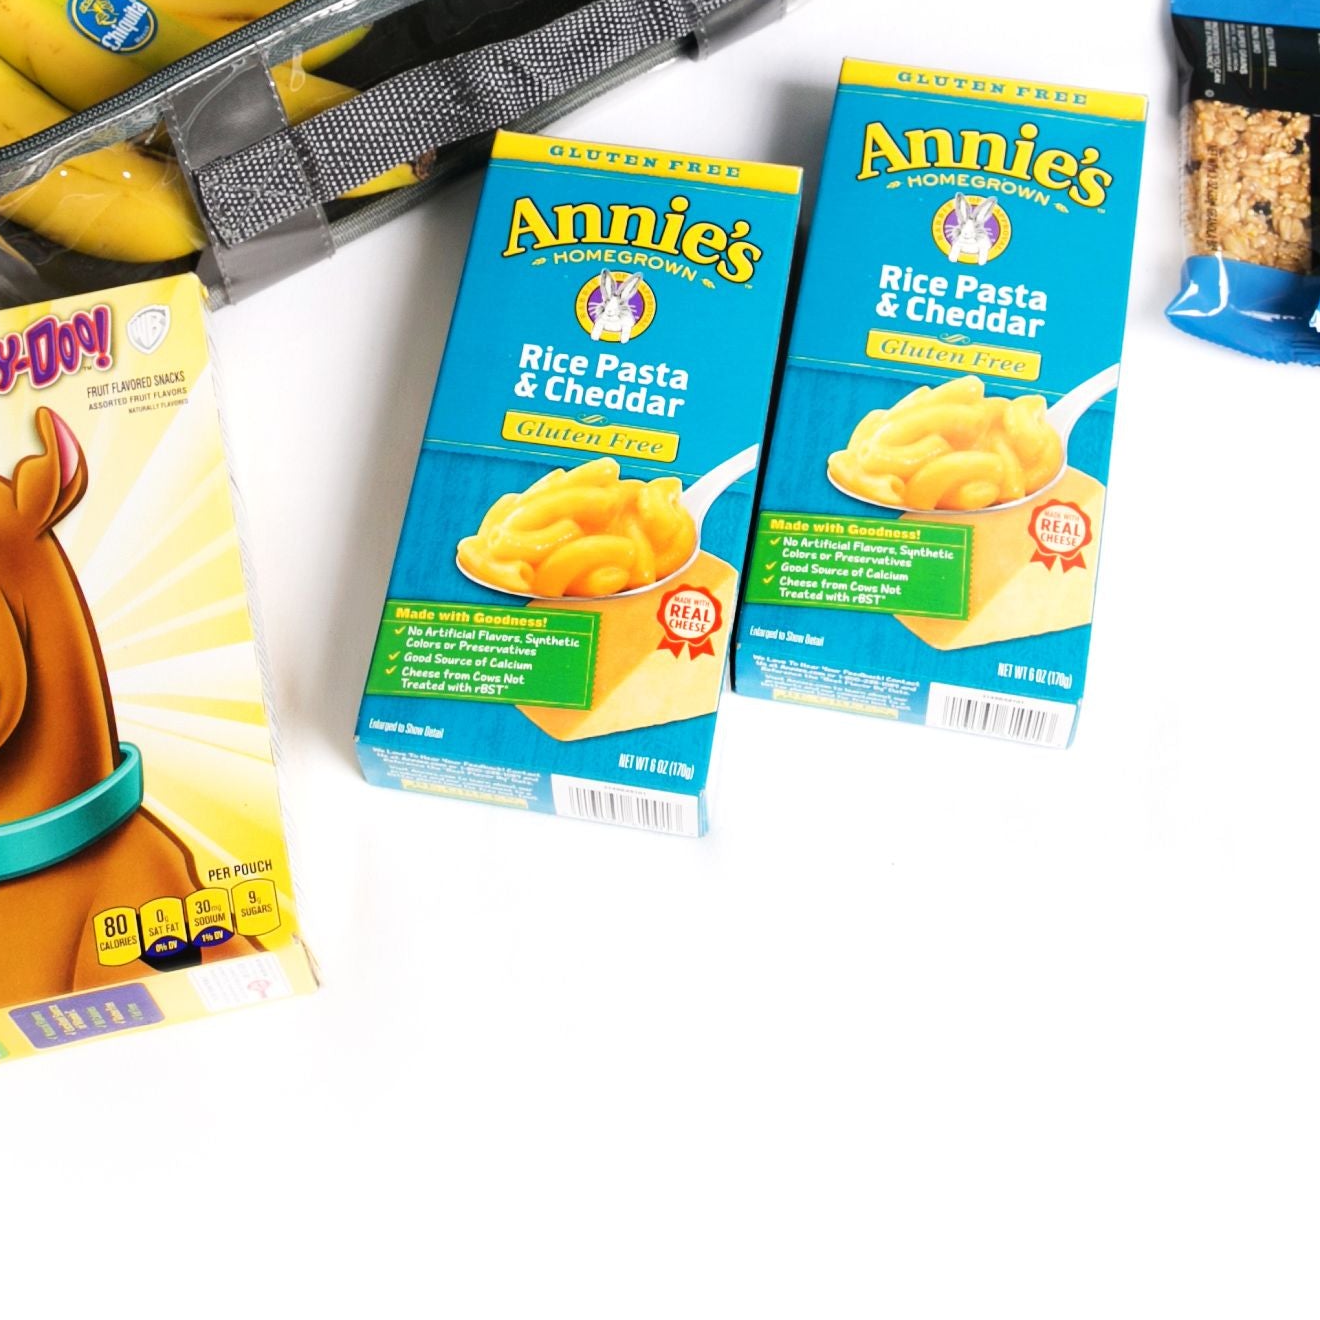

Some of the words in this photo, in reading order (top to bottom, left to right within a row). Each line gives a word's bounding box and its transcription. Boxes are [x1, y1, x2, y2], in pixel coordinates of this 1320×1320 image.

[897, 72, 1005, 93] GLUTEN
[1016, 87, 1087, 105] FREE
[550, 145, 658, 168] GLUTEN
[669, 161, 740, 178] FREE
[857, 121, 1113, 207] Annie's
[907, 174, 1050, 206] HOMEGROWN
[502, 196, 762, 283] Annie's
[553, 249, 697, 281] HOMEGROWN
[879, 264, 948, 297] Rice
[955, 275, 1047, 311] Pasta
[876, 293, 899, 318] &
[906, 296, 1045, 338] Cheddar
[519, 343, 588, 376] Rice
[595, 354, 689, 390] Pasta
[881, 339, 964, 364] Gluten
[972, 351, 1026, 373] Free
[87, 384, 109, 398] FRUIT
[112, 377, 151, 393] FLAVORED
[154, 371, 185, 386] SNACKS
[89, 398, 127, 410] ASSORTED
[130, 393, 151, 402] FRUIT
[154, 387, 187, 398] FLAVORS
[514, 373, 538, 398] &
[545, 376, 685, 418] Cheddar
[518, 420, 601, 445] Gluten
[609, 432, 663, 454] Free
[770, 519, 809, 532] Made
[813, 522, 844, 534] with
[848, 524, 921, 540] Goodness!
[1041, 518, 1080, 537] REAL
[783, 537, 798, 546] No
[801, 538, 850, 550] Artificial
[900, 545, 954, 559] Synthetic
[1041, 533, 1076, 546] CHEESE
[782, 548, 817, 559] Colors
[820, 552, 831, 560] or
[835, 552, 912, 567] Preservatives
[781, 562, 808, 572] Good
[811, 564, 848, 576] Source
[852, 567, 863, 577] of
[866, 568, 908, 581] Calcium
[779, 576, 817, 588] Cheese
[821, 579, 847, 590] from
[850, 582, 878, 593] Cows
[881, 584, 901, 595] Not
[779, 588, 823, 600] Treated
[826, 591, 850, 601] with
[396, 608, 434, 620] Made
[439, 611, 469, 623] with
[474, 613, 547, 628] Goodness!
[670, 604, 711, 622] REAL
[408, 626, 422, 636] No
[425, 627, 475, 639] Artificial
[526, 634, 579, 647] Synthetic
[669, 619, 705, 633] CHEESE
[406, 638, 441, 649] Colors
[444, 642, 456, 650] or
[459, 642, 536, 656] Preservatives
[404, 652, 432, 663] Good
[434, 654, 472, 666] Source
[475, 657, 487, 667] of
[490, 658, 532, 670] Calcium
[401, 679, 444, 691] Treated
[448, 682, 471, 692] with
[402, 667, 440, 678] Cheese
[444, 670, 470, 680] from
[473, 673, 502, 683] Cows
[504, 674, 525, 684] Not
[998, 663, 1013, 677] NET
[1015, 665, 1028, 680] WT
[1029, 669, 1035, 681] 6
[1036, 669, 1047, 684] OZ
[1048, 671, 1073, 689] (170g)
[619, 753, 634, 768] NET
[636, 756, 649, 770] WT
[650, 760, 656, 772] 6
[657, 760, 668, 774] OZ
[669, 762, 694, 780] (170g)
[209, 867, 230, 881] PER
[234, 860, 272, 877] POUCH
[194, 913, 226, 927] SODIUM
[241, 904, 272, 917] SUGARS
[104, 914, 127, 937] 80
[149, 926, 164, 936] SAT
[166, 923, 180, 933] FAT
[99, 936, 137, 951] CALORIES
